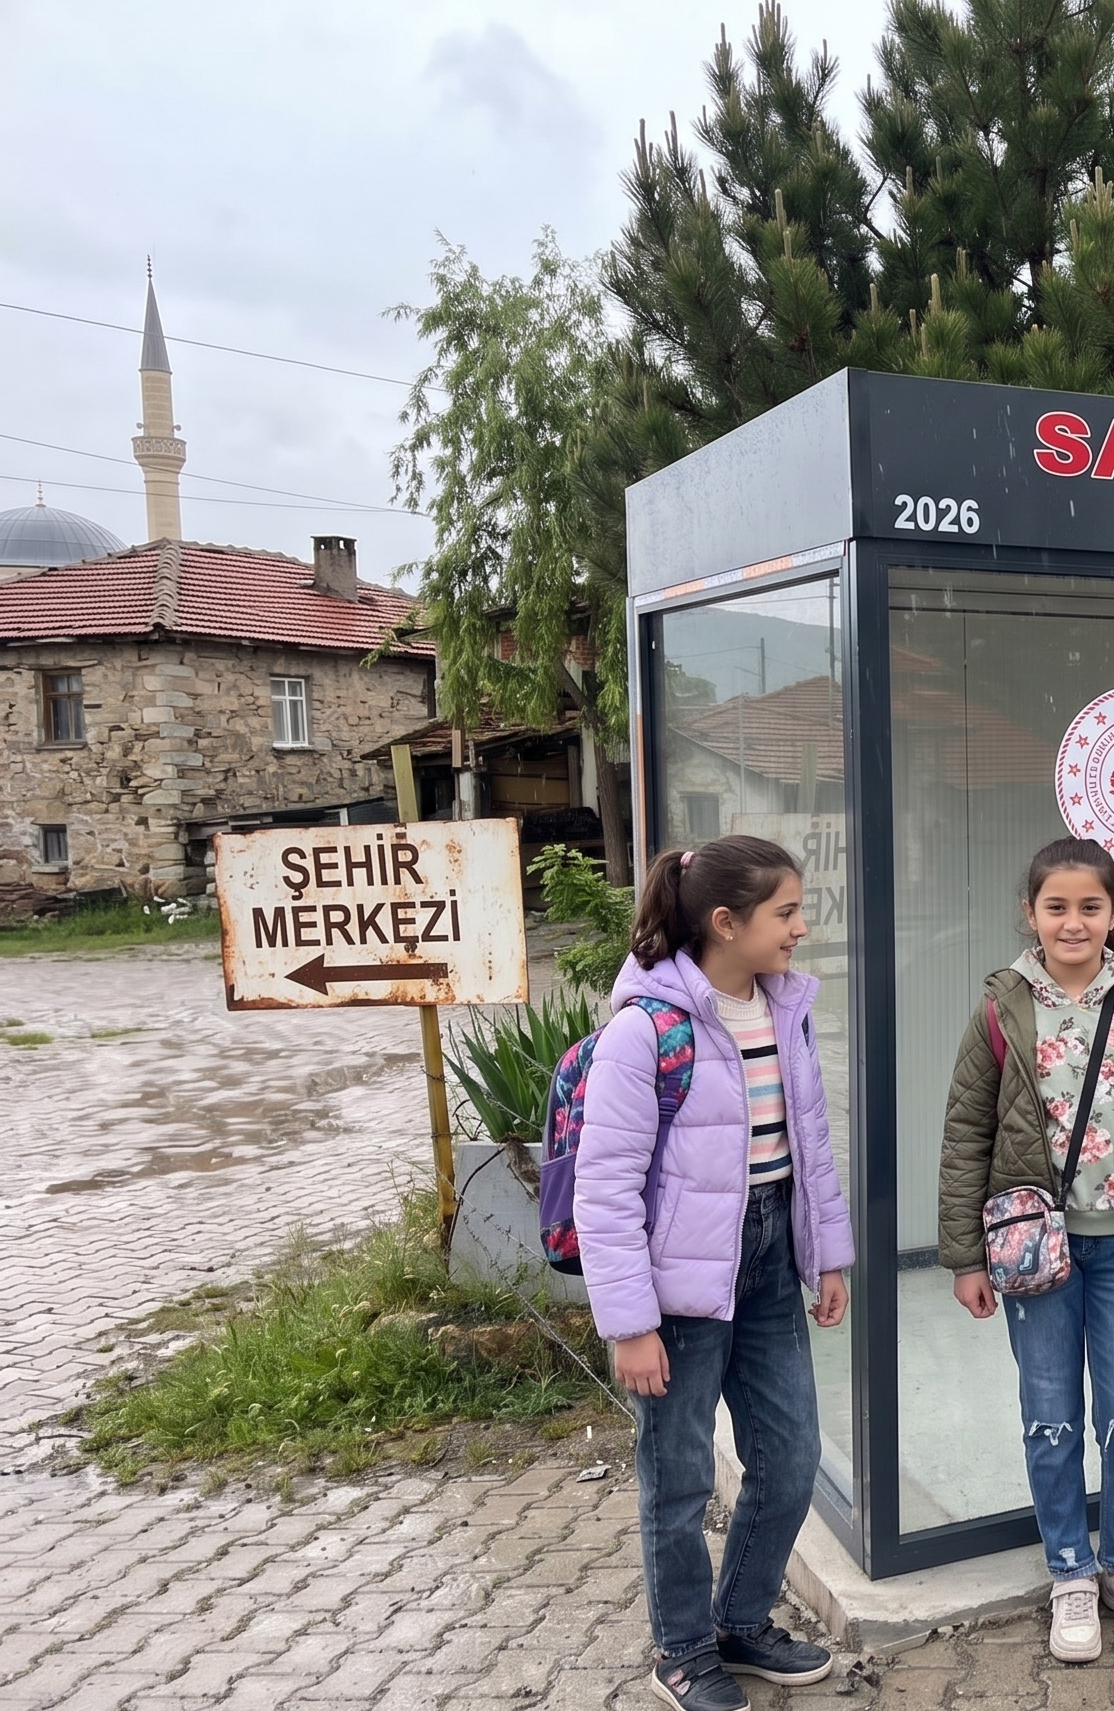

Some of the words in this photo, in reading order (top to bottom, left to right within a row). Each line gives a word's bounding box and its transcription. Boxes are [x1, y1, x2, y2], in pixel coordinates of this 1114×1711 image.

[893, 494, 980, 534] 2026
[281, 832, 424, 900] ŞEHİR
[252, 889, 461, 949] MERKEZİ
